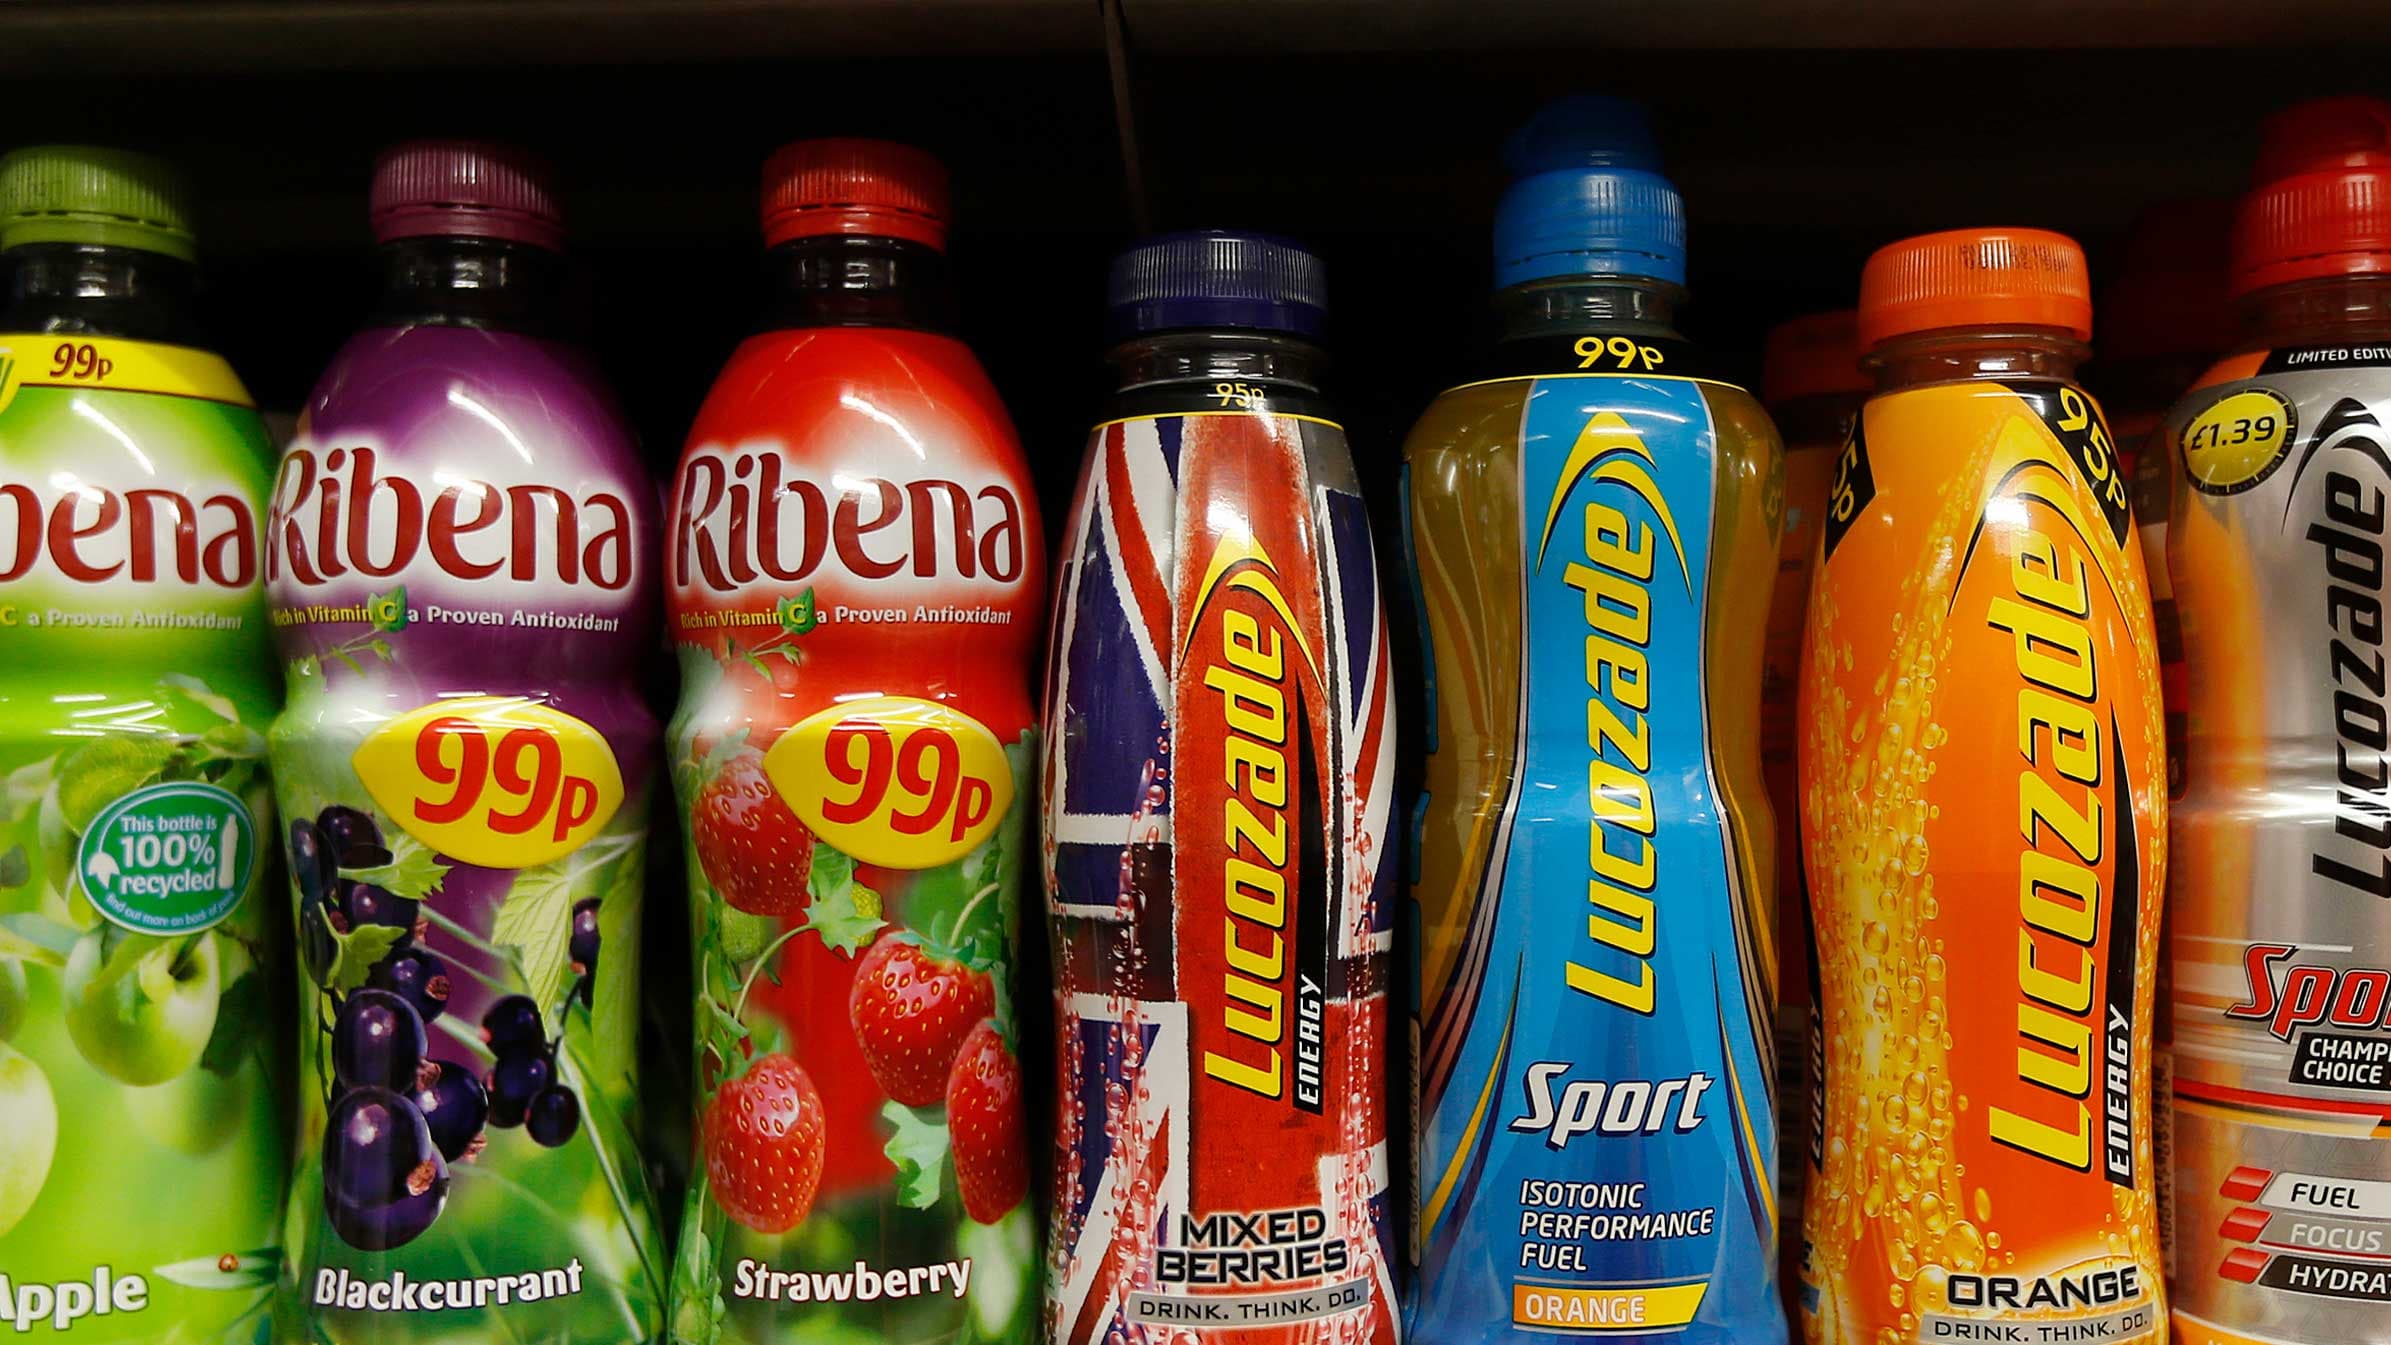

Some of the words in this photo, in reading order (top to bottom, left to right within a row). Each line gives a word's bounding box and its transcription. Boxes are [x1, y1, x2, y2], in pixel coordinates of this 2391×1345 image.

[49, 343, 113, 380] 99p
[2288, 349, 2349, 364] LIMITED
[2191, 416, 2275, 450] £1.39
[266, 448, 633, 591] Ribena
[676, 452, 1025, 592] Ribena
[28, 614, 40, 626] a
[47, 608, 121, 629] Proven
[131, 612, 242, 630] Antioxidant
[293, 606, 306, 624] in
[308, 603, 372, 622] Vitamin
[380, 601, 396, 621] C
[408, 607, 419, 622] a
[427, 605, 504, 626] Proven
[511, 609, 620, 632] Antioxidant
[681, 612, 702, 630] Rich
[704, 611, 717, 628] in
[720, 609, 783, 627] Vitamin
[789, 604, 806, 625] C
[817, 609, 827, 624] a
[835, 605, 907, 624] Proven
[913, 605, 1012, 625] Antioxidant
[2306, 471, 2391, 899] Lucozade
[1562, 503, 1656, 1016] Lucozade
[413, 717, 599, 843] 99p
[822, 718, 993, 842] 99p
[121, 816, 154, 833] This
[158, 815, 203, 832] bottle
[207, 815, 218, 831] is
[119, 833, 216, 868] 100%
[1204, 608, 1287, 1098] Lucozade
[1986, 533, 2102, 1174] Lucozade
[120, 868, 216, 898] recycled
[2224, 943, 2391, 1044] Spo
[1298, 973, 1323, 1105] ENERGY
[2107, 1003, 2130, 1177] ENERGY
[2303, 1060, 2383, 1084] CHOICE
[1508, 1060, 1714, 1149] Sport
[1520, 1179, 1645, 1209] ISOTONIC
[2290, 1183, 2360, 1209] FUEL
[1178, 1207, 1327, 1250] MIXED
[1520, 1208, 1714, 1240] PERFORMANCE
[2289, 1223, 2382, 1252] FOCUS
[1155, 1238, 1349, 1284] BERRIES
[1520, 1241, 1588, 1272] FUEL
[314, 1258, 584, 1312] Blackcurrant
[734, 1257, 973, 1302] Strawberry
[1947, 1264, 2140, 1310] ORANGE
[2288, 1263, 2391, 1294] HYDRA
[1139, 1298, 1229, 1322] DRINK.
[1237, 1293, 1321, 1318] THINK.
[1328, 1289, 1362, 1308] DO.
[1523, 1293, 1646, 1324] ORANGE
[1934, 1320, 2029, 1342] DRINK.
[2037, 1318, 2116, 1339] THINK.
